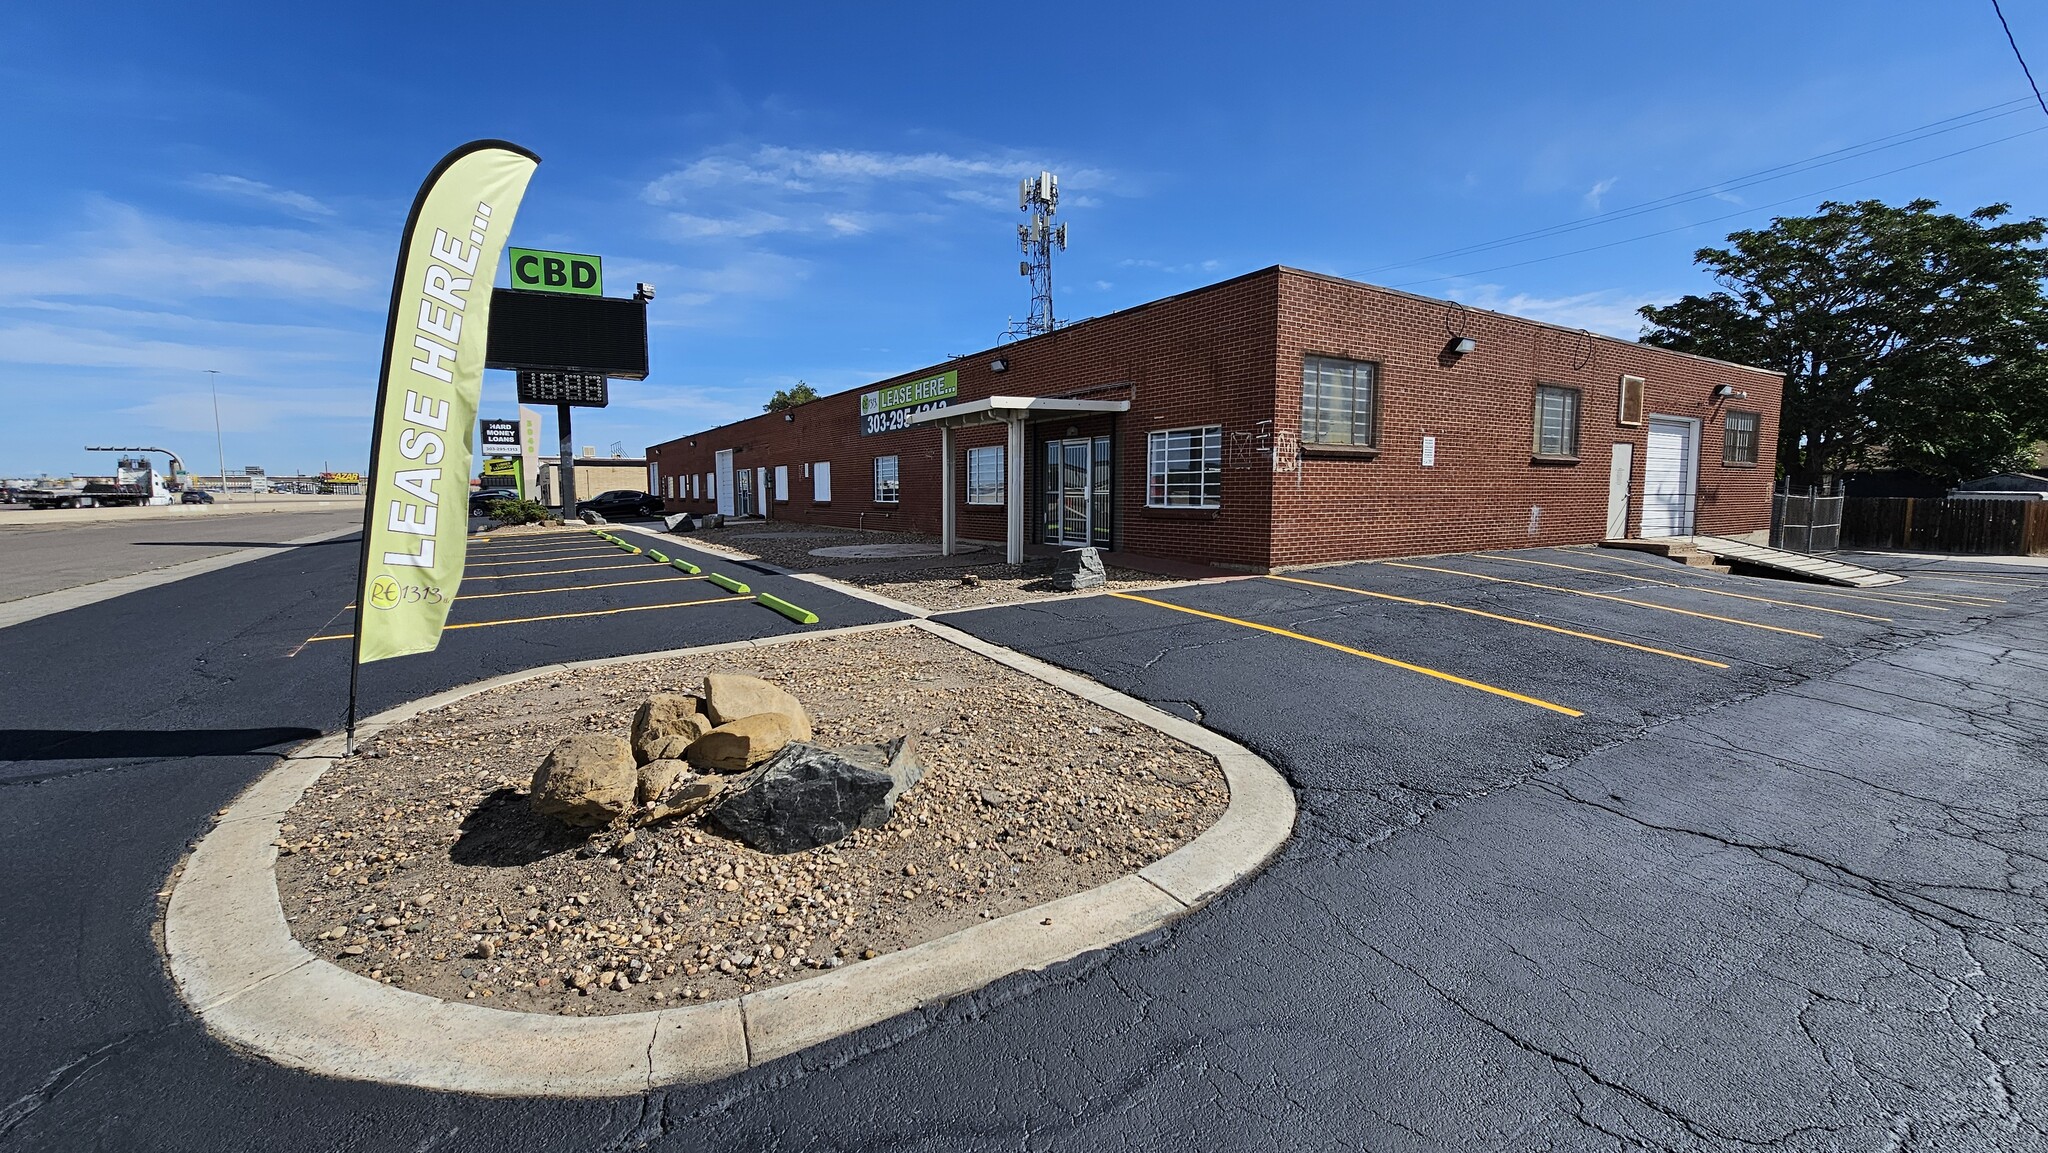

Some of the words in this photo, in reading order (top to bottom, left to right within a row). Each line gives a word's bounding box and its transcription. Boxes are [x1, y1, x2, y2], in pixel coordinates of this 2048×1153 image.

[515, 255, 597, 289] CBD
[410, 201, 492, 384] HERE...
[881, 385, 912, 408] LEASE
[915, 376, 956, 400] HERE...
[867, 400, 947, 434] 303-295
[383, 389, 450, 568] LEASE
